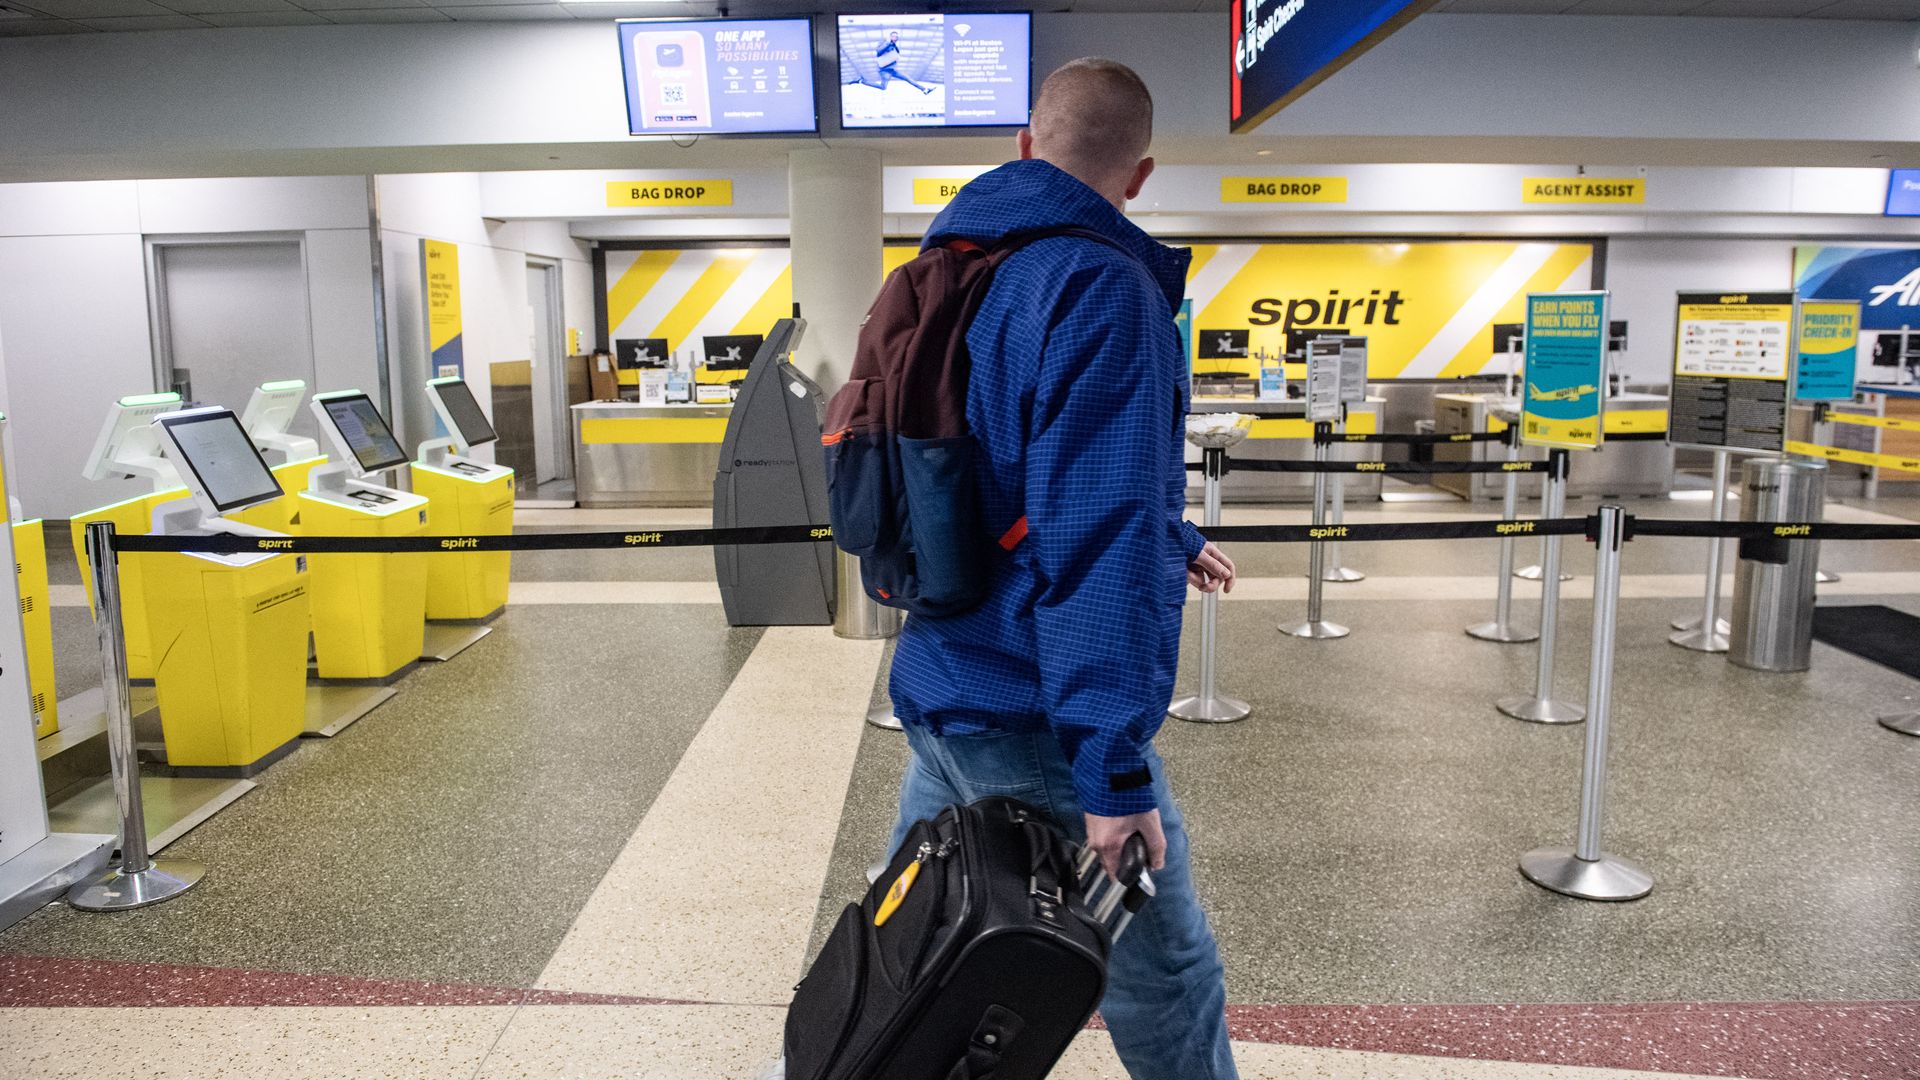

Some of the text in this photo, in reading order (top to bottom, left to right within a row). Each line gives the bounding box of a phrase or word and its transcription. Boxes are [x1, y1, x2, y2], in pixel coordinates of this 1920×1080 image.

[715, 30, 766, 42] ONE APP
[716, 41, 770, 51] SO MANY
[716, 50, 799, 62] POSSIBILITIES
[632, 187, 706, 199] BAG DROP
[1247, 183, 1322, 195] BAG DROP
[1534, 185, 1635, 196] AGENT ASSIST
[1720, 295, 1748, 304] spirit
[1248, 289, 1404, 334] spirit
[1532, 301, 1594, 314] EARN POINTS
[1532, 315, 1600, 328] WHEN YOU FLY
[1804, 314, 1852, 325] PRIORITY
[1804, 327, 1852, 338] CHECK-IN
[1356, 462, 1387, 472] spirit
[1503, 461, 1532, 471] spirit
[1309, 526, 1348, 538] spirit
[1496, 522, 1536, 533] spirit
[1773, 525, 1811, 536] spirit
[258, 539, 293, 549] spirit
[441, 537, 478, 549] spirit
[624, 533, 662, 545] spirit
